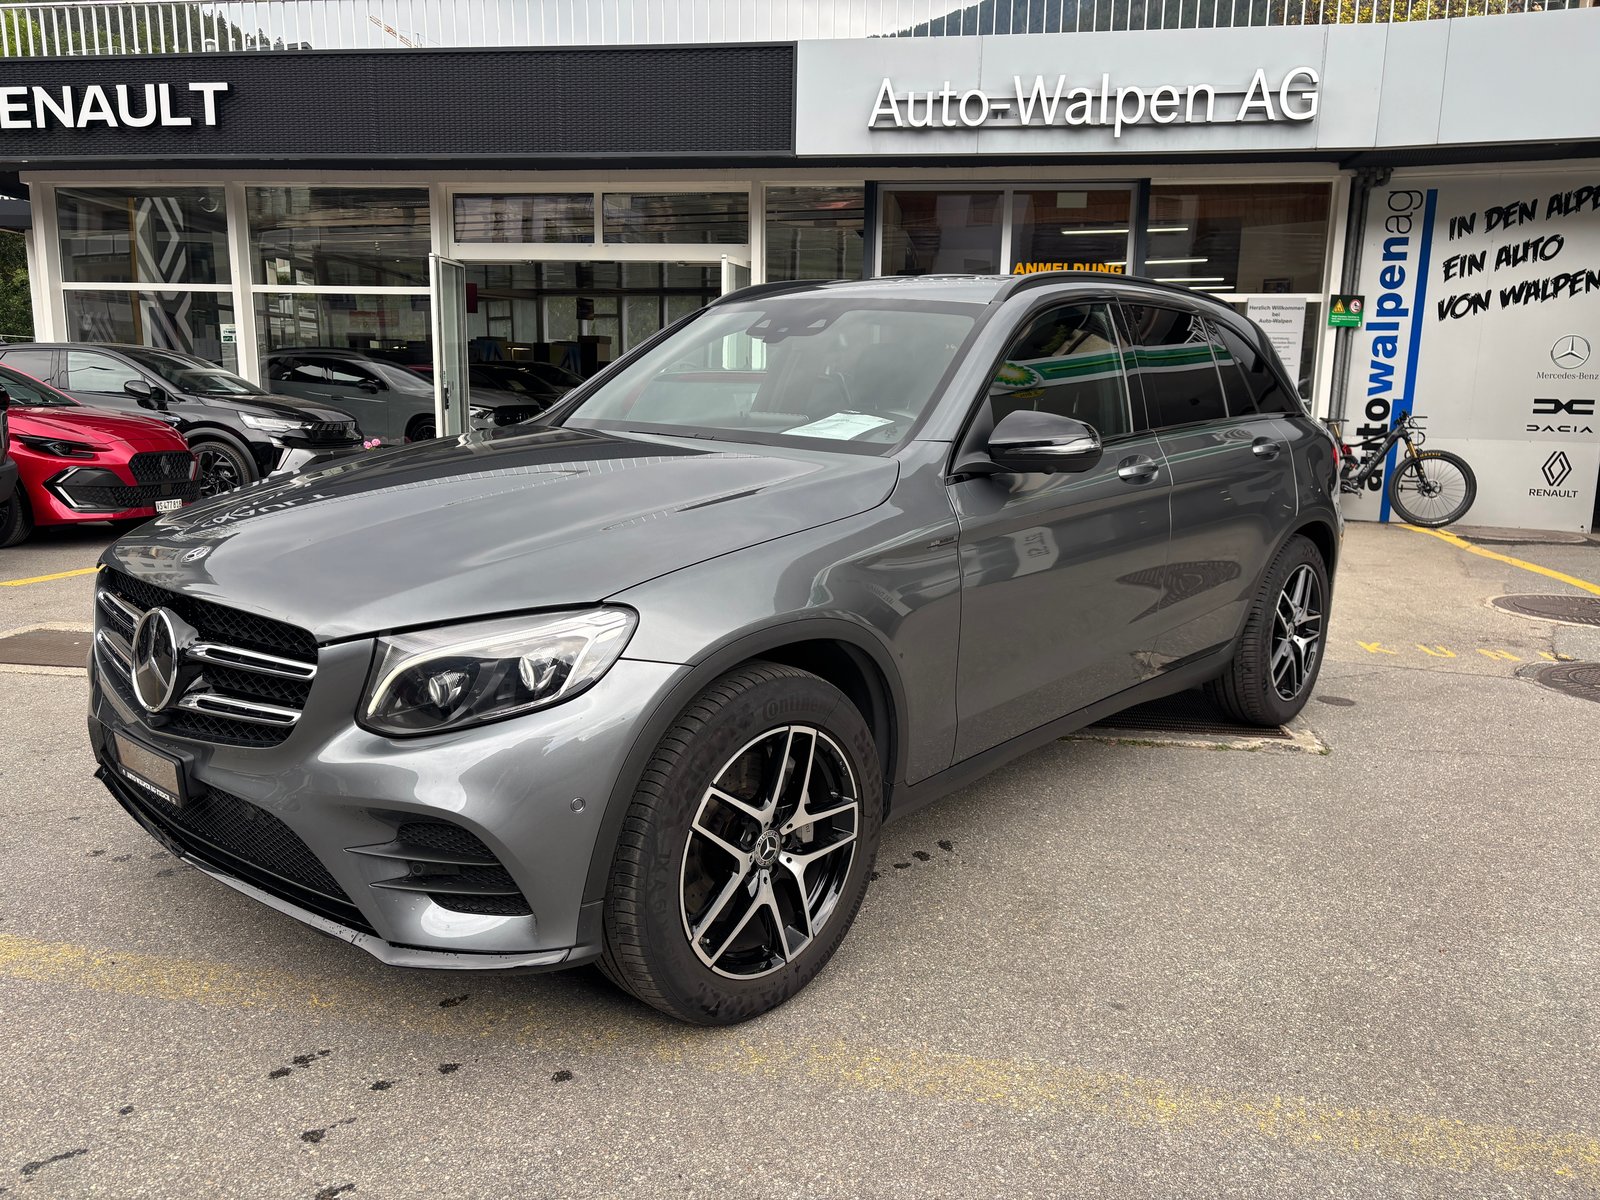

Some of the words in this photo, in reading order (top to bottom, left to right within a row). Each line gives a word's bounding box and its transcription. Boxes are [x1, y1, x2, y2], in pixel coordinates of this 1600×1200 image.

[0, 82, 229, 129] ENAULT
[868, 73, 1214, 138] Auto-Walpen
[1236, 66, 1319, 121] AG
[1449, 212, 1477, 241] IN
[1484, 199, 1538, 234] DEN
[1013, 262, 1123, 275] ANMELDUNG
[1443, 250, 1487, 283] EIN
[1494, 234, 1564, 272] AUTO
[1438, 289, 1492, 322] VON
[1500, 269, 1600, 310] WALPEN
[1536, 371, 1600, 380] Mercedes-Benz
[1526, 424, 1593, 434] DACIA
[1529, 488, 1579, 498] RENAULT
